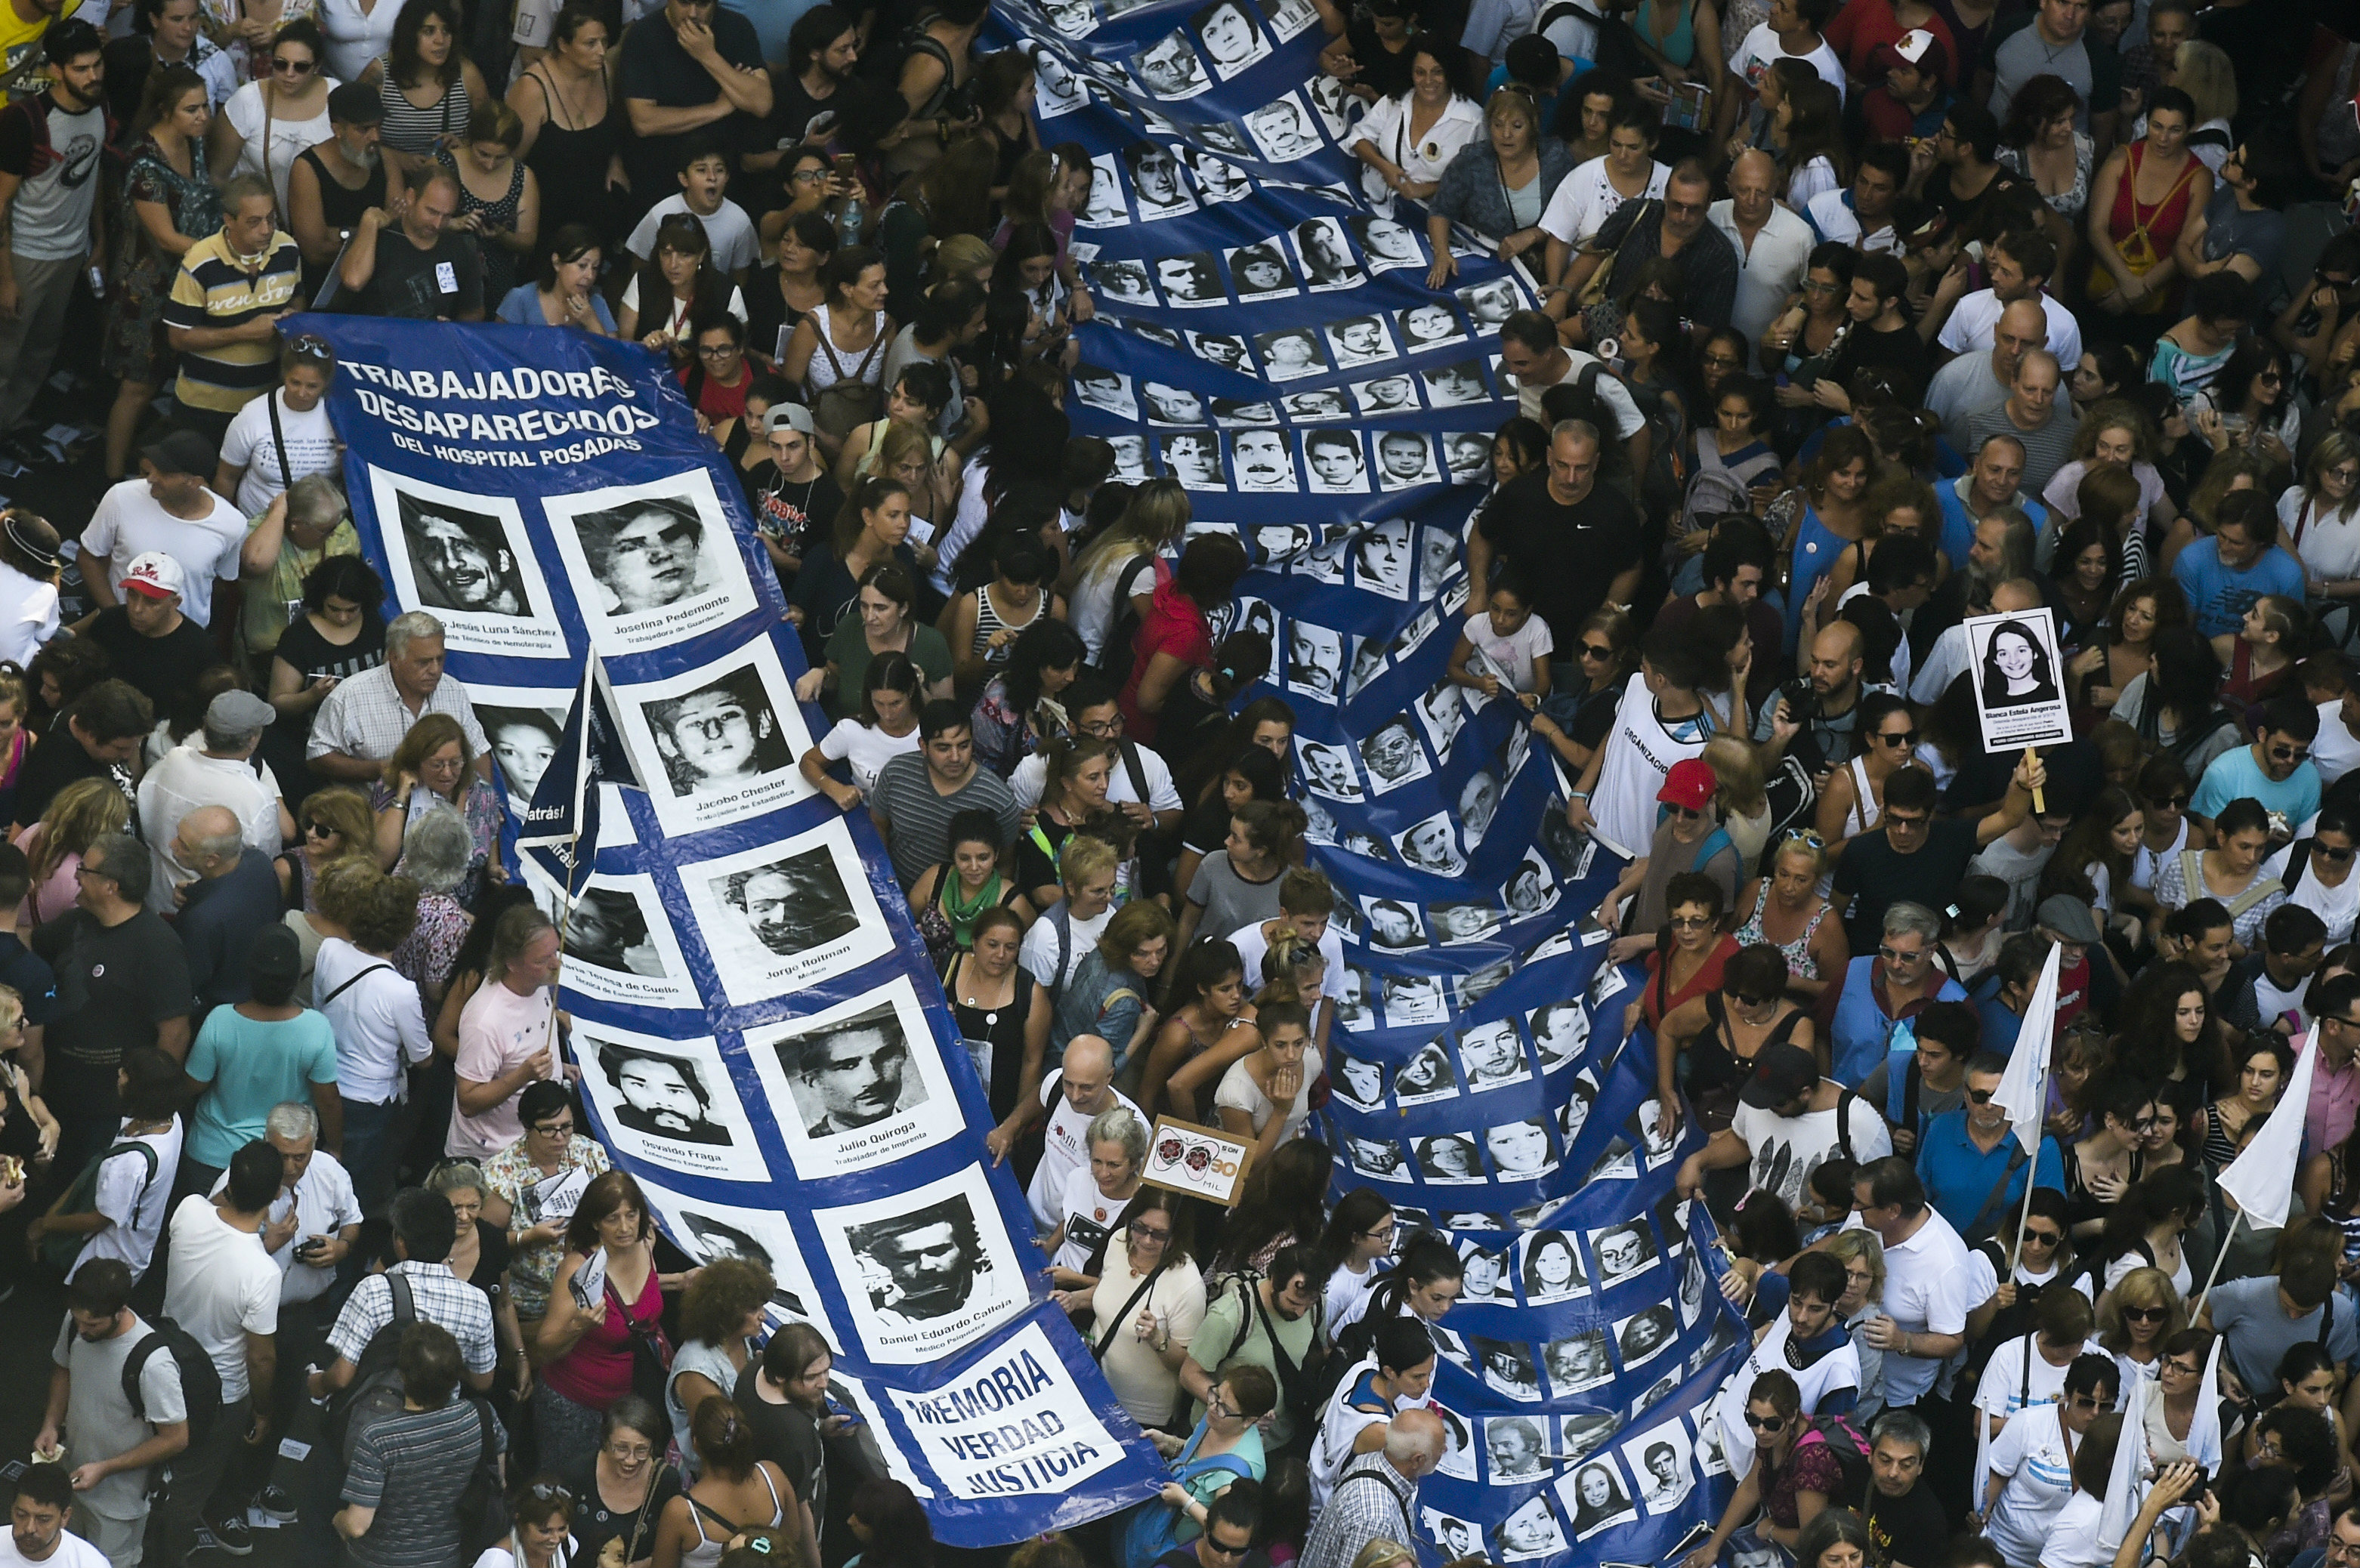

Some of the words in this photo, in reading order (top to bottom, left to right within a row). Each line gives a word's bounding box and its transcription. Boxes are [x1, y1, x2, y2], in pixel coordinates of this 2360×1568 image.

[338, 360, 636, 400] TRABAJADORES
[354, 388, 660, 441] DESAPARECIDOS
[392, 432, 431, 457] DEL
[433, 444, 536, 468] HOSPITAL
[539, 437, 642, 466] POSADAS
[450, 621, 480, 633] Jesús
[482, 625, 509, 634] Luna
[512, 625, 557, 637] Sánchez
[614, 619, 663, 635] Josefina
[666, 595, 730, 623] Pedemonte
[503, 640, 552, 649] Hemoterapia
[627, 630, 674, 644] Trabajadora
[2031, 705, 2061, 713] Angerosa
[1625, 727, 1670, 776] ORGANIZACIO
[696, 795, 738, 811] Jacobo
[741, 779, 786, 798] Chester
[528, 805, 564, 822] atrás!
[766, 965, 799, 980] Jorge
[802, 946, 851, 968] Roitman
[587, 970, 622, 988] Teresa
[626, 982, 639, 990] de
[642, 984, 679, 994] Cuello
[642, 1139, 685, 1156] Osvaldo
[687, 1150, 721, 1162] Fraga
[834, 1150, 878, 1165] Trabajador
[891, 1132, 927, 1150] Imprenta
[838, 1139, 867, 1153] Julio
[870, 1122, 916, 1144] Quiroga
[1210, 1159, 1237, 1178] 30
[1203, 1181, 1222, 1191] MIL
[879, 1333, 918, 1345] Daniel
[921, 1319, 971, 1340] Eduardo
[973, 1298, 1012, 1321] Calleja
[947, 1323, 986, 1344] Psiquiatra
[905, 1348, 1055, 1424] MEMORIA
[940, 1409, 1065, 1461] VERDAD
[966, 1440, 1099, 1495] JUSTICIA
